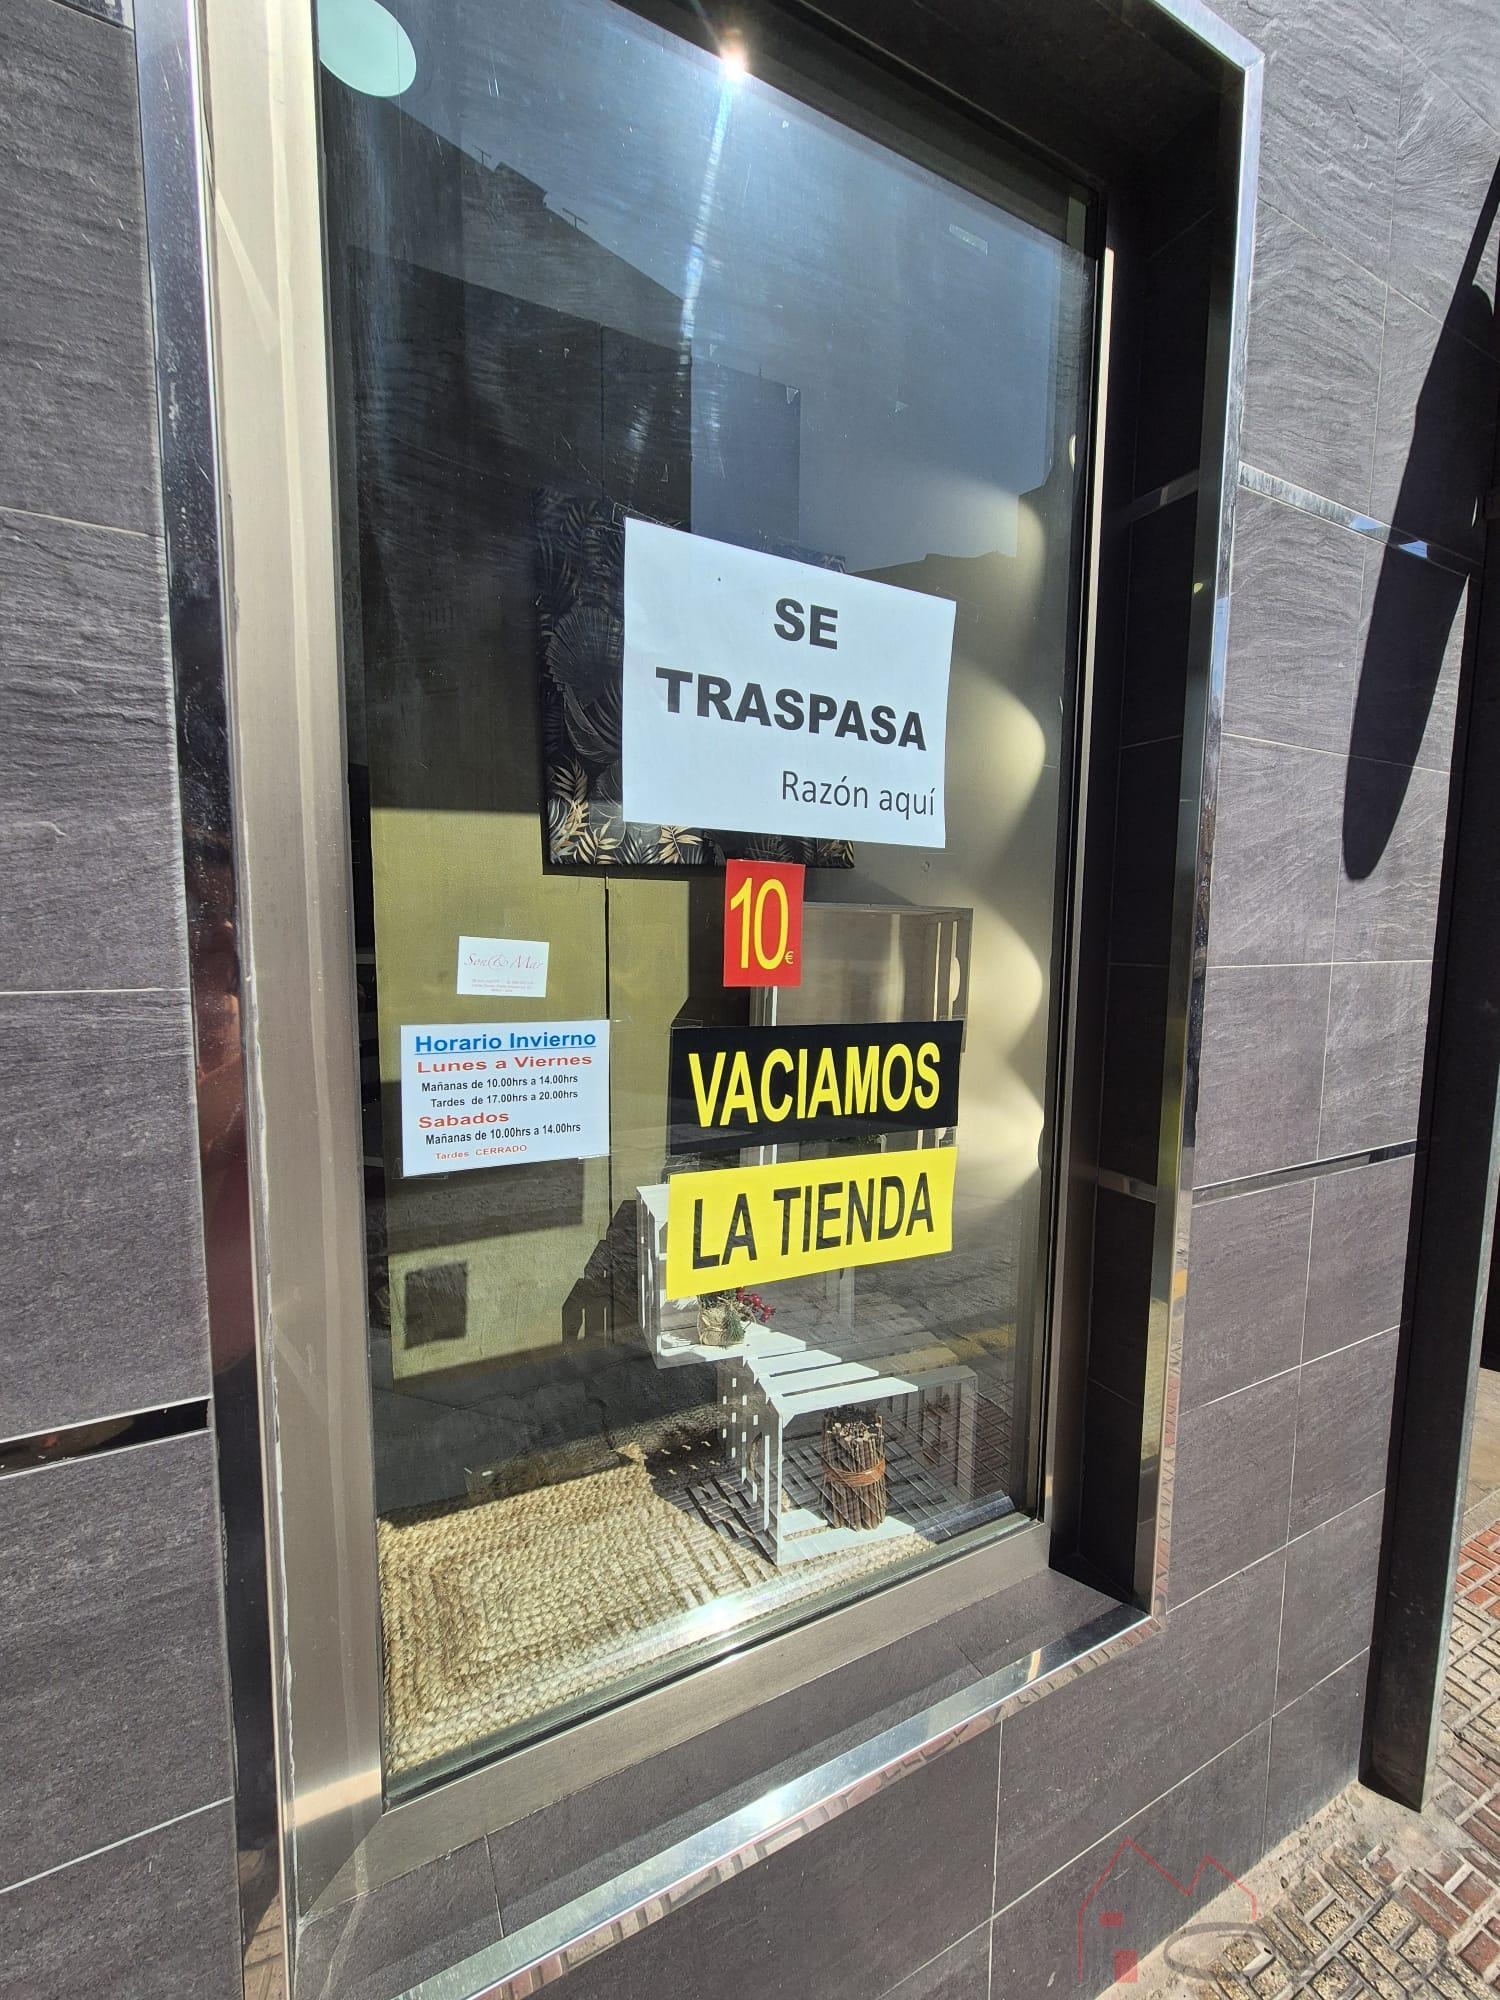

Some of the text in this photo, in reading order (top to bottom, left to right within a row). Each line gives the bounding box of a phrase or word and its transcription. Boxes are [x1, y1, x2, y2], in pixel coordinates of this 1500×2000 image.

[774, 598, 838, 650] SE
[655, 667, 927, 751] TRASPASA
[781, 770, 936, 820] Razón aquí
[415, 1031, 596, 1052] Horario Invierno
[417, 1055, 592, 1073] Lunes a Viernes
[421, 1074, 578, 1092] Mañanas de 10.00hrs a 14.00hrs
[688, 1041, 941, 1128] VACIAMOS
[430, 1090, 578, 1108] Tardes de 17.00hrs a 20.00hrs
[418, 1112, 510, 1129] Sabados
[425, 1123, 582, 1146] Mañanas de 10.00hrs a 14.00hrs
[435, 1144, 528, 1161] Tardes CERRADO
[691, 1172, 935, 1271] LA TIENDA
